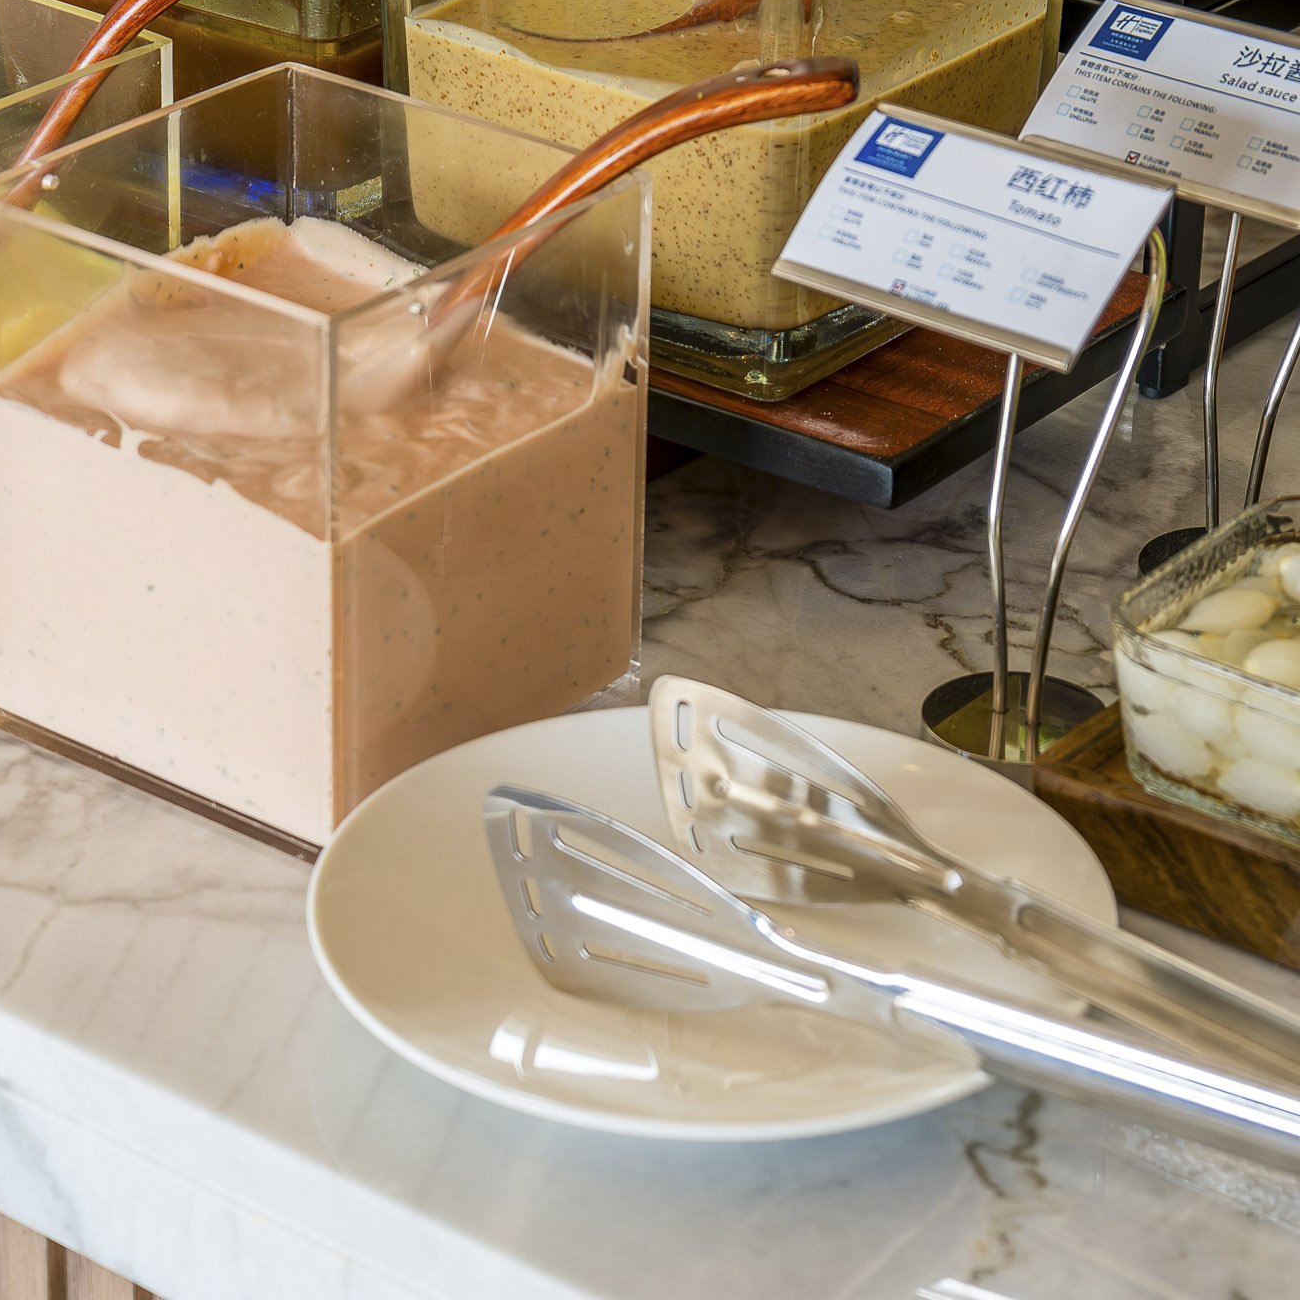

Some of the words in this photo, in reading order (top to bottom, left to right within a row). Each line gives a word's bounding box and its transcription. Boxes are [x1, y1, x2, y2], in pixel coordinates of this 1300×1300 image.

[1074, 68, 1092, 79] THIS
[1092, 72, 1112, 84] ITEM
[1112, 78, 1152, 95] CONTAINS
[1152, 89, 1168, 100] THE
[1219, 73, 1259, 91] Salad
[1258, 85, 1298, 102] sauce
[1007, 165, 1095, 210] 西红柿
[1008, 198, 1062, 227] Tomato
